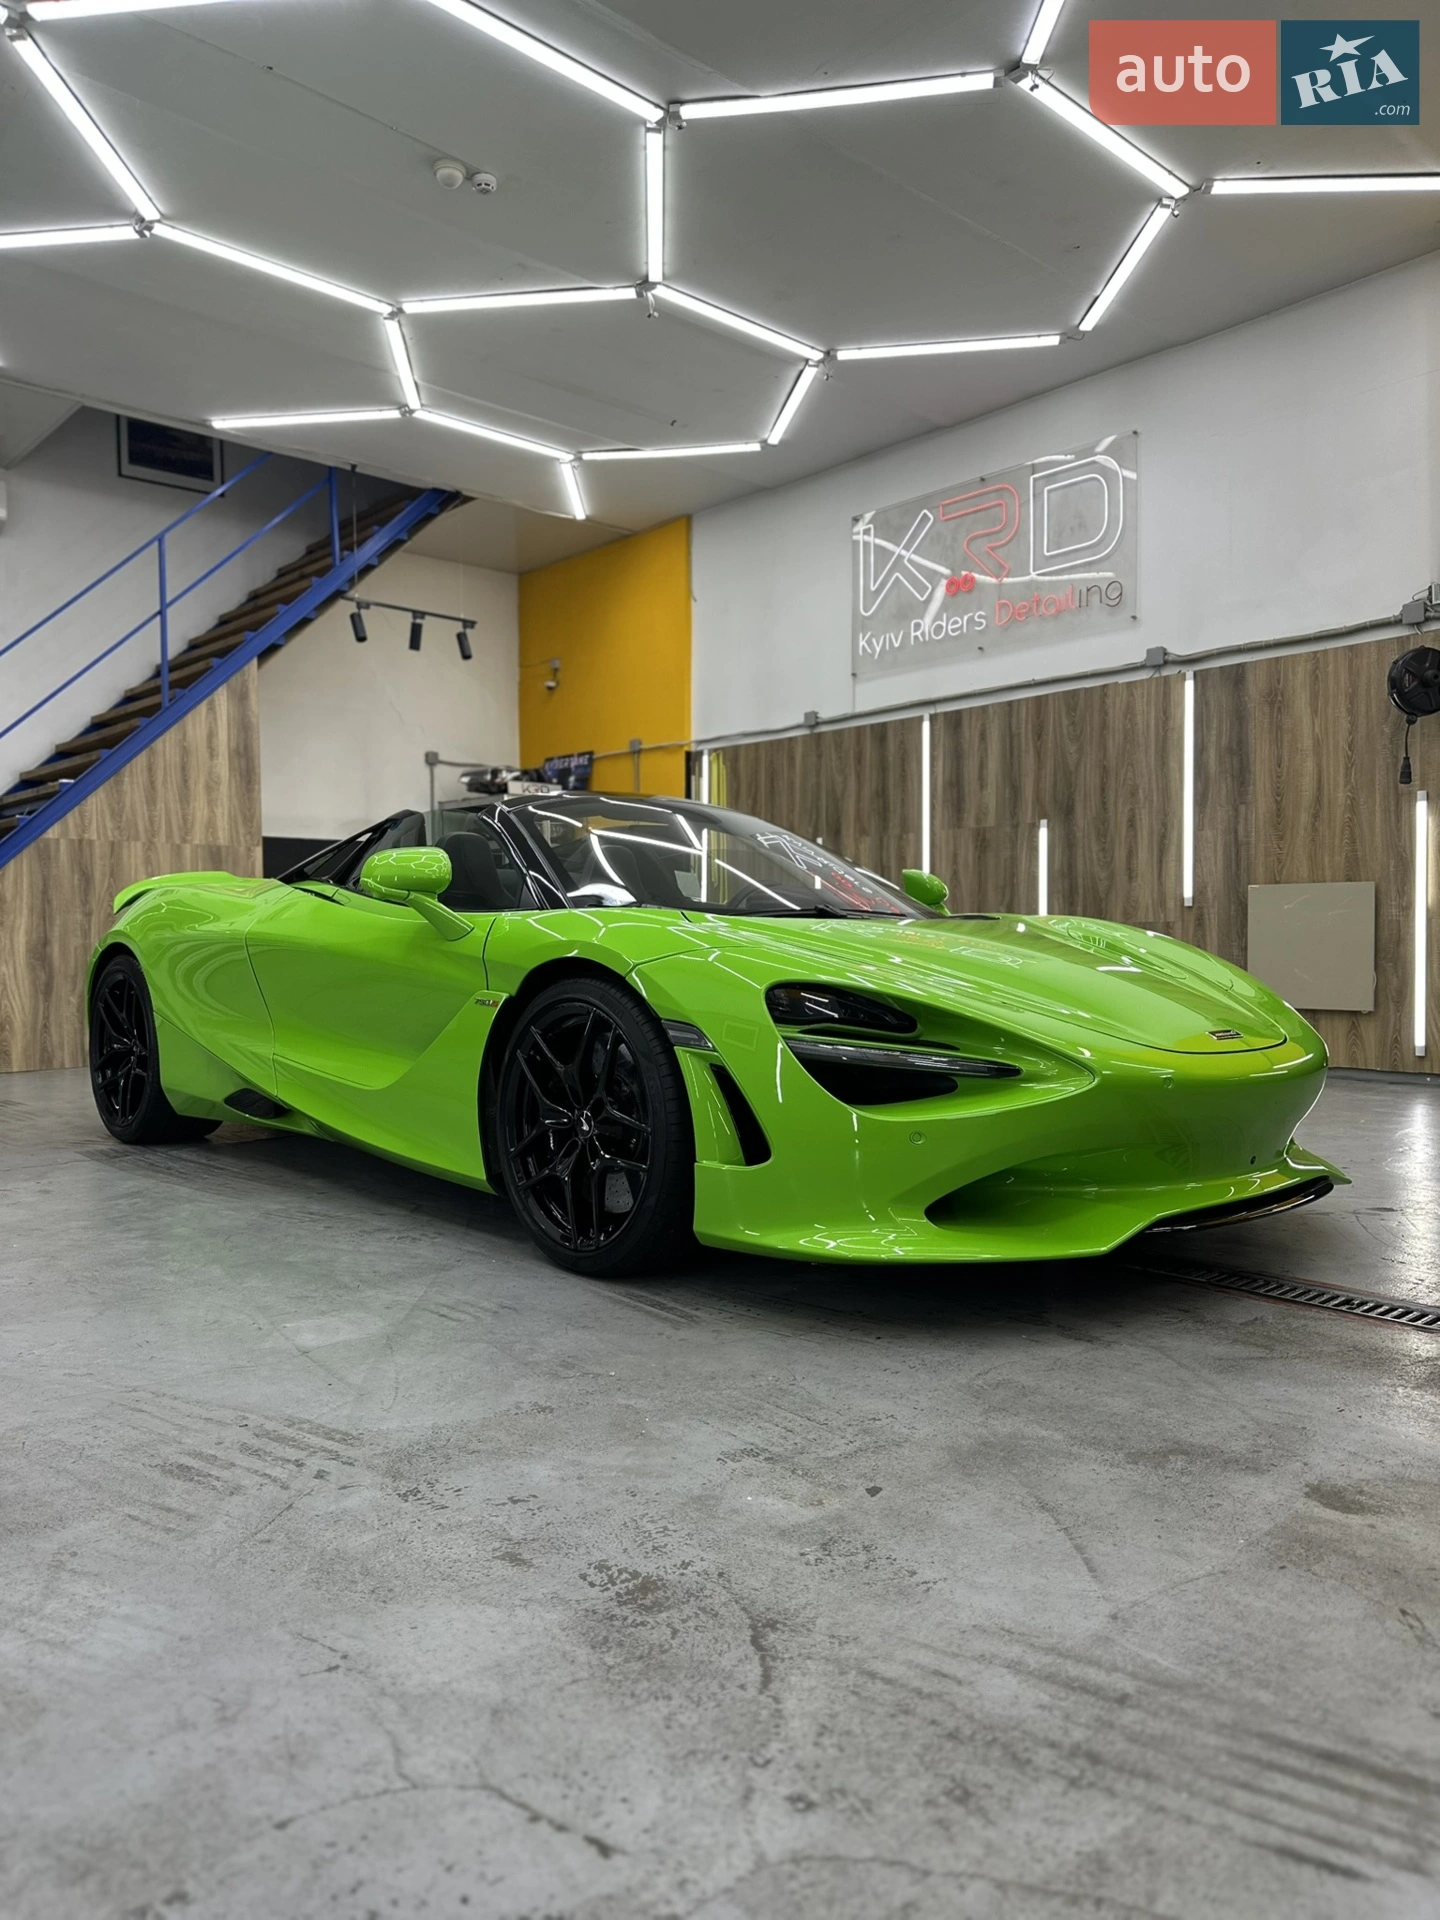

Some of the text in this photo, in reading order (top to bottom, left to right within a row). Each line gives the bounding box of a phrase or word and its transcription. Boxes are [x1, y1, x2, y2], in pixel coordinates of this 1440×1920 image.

[860, 455, 1123, 617] KRD
[858, 580, 1124, 659] Kyiv Riders Detailing
